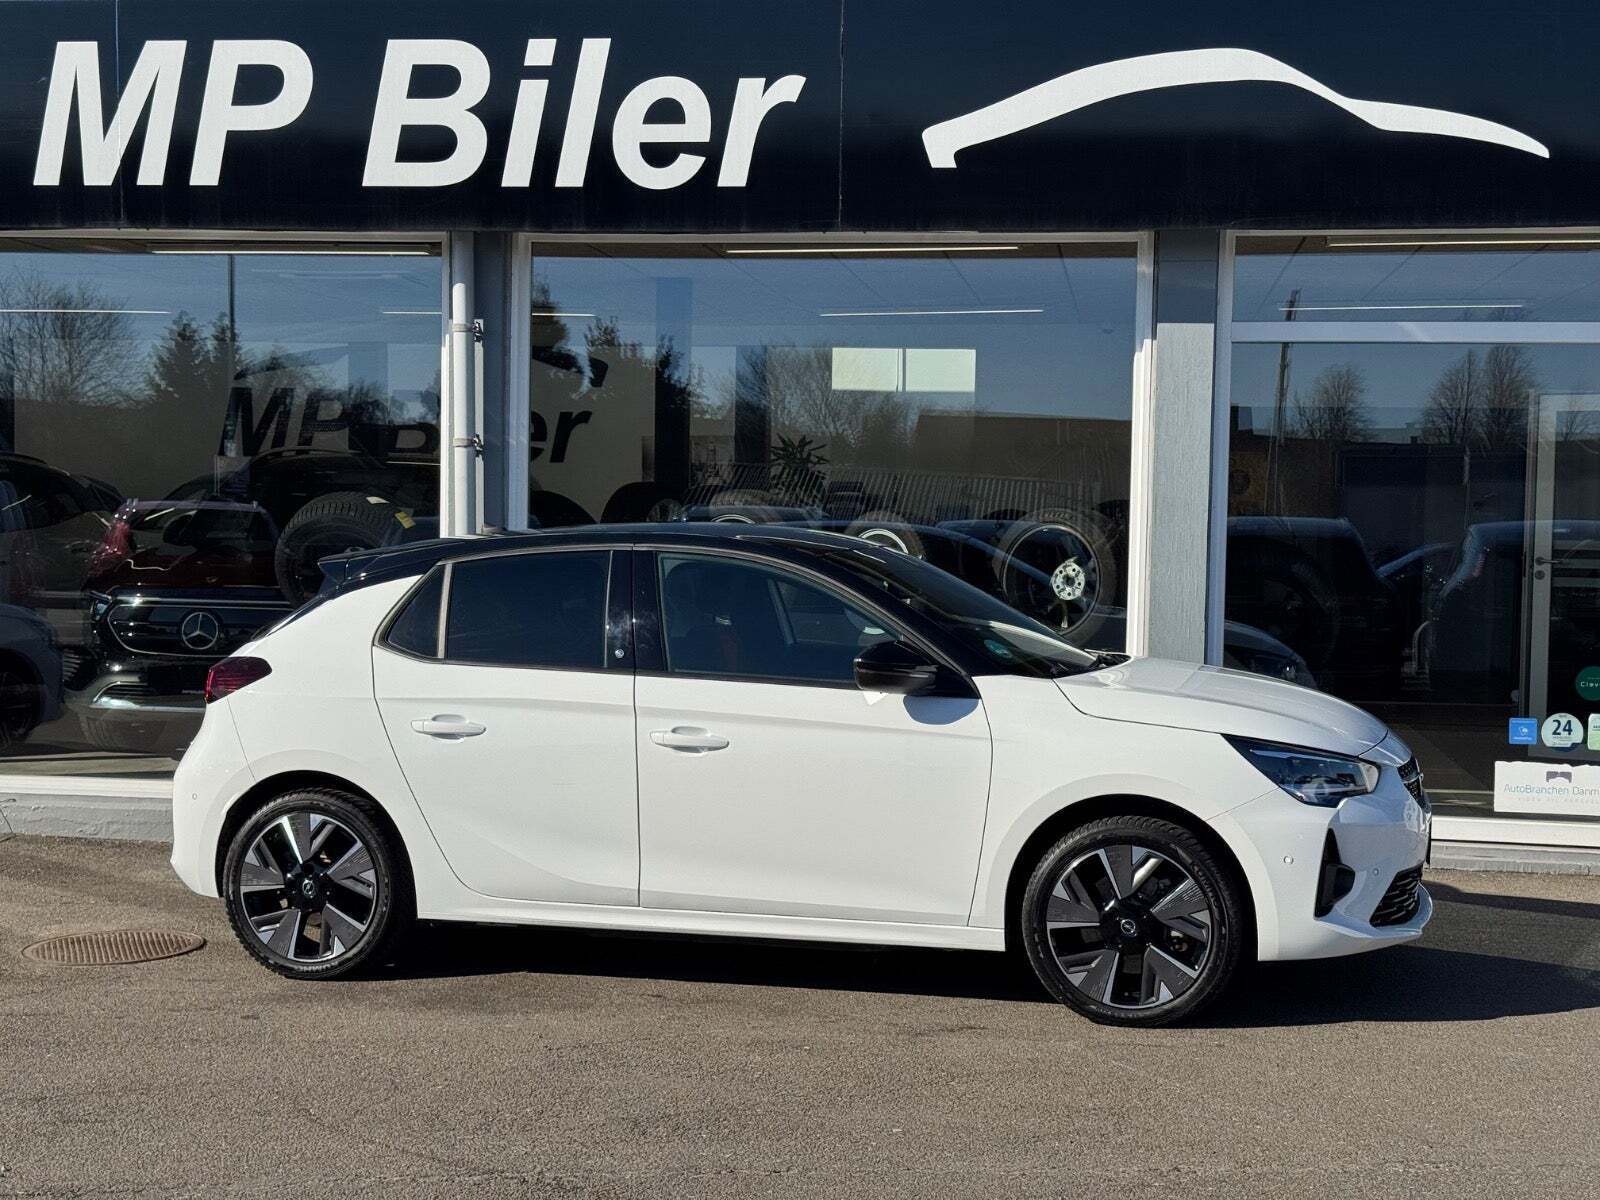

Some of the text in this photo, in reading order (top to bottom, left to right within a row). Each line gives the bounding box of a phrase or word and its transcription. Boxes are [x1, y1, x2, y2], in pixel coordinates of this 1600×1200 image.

[33, 38, 806, 189] MP Biler
[1552, 719, 1573, 736] 24
[1504, 783, 1569, 796] AutoBranchen
